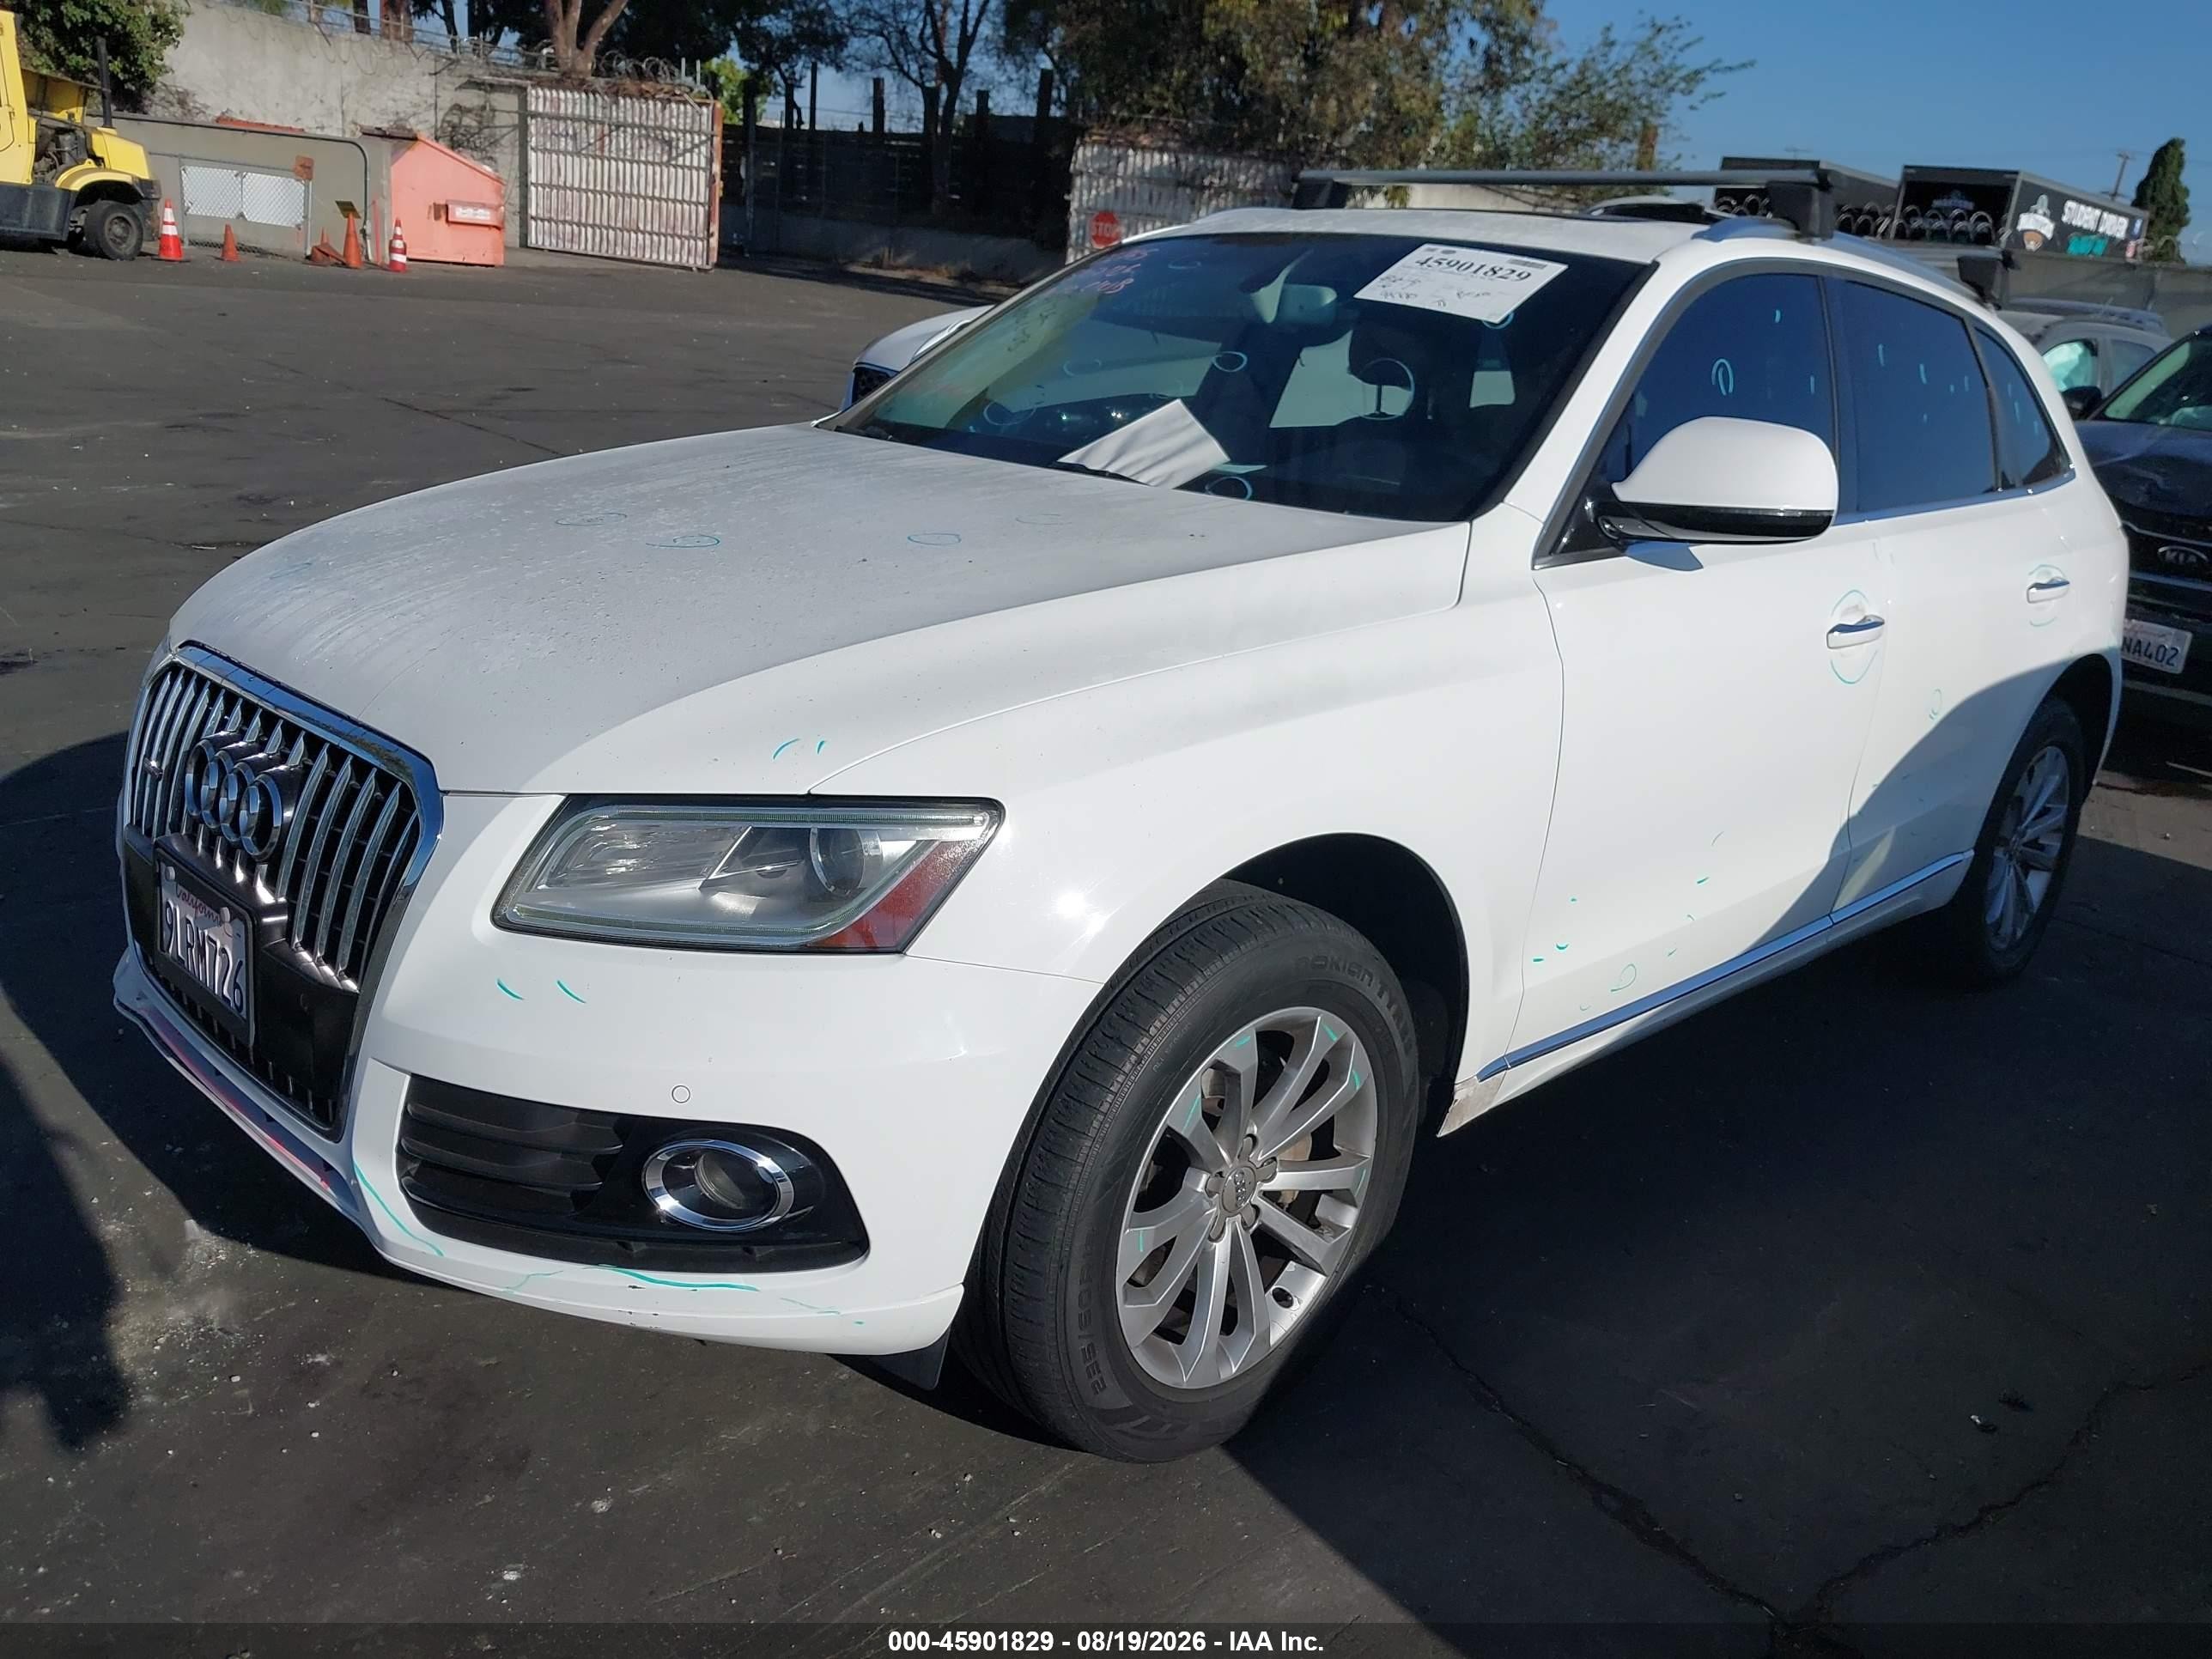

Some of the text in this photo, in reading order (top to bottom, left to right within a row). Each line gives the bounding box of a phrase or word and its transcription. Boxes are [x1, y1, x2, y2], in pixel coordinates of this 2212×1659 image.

[1091, 222, 1120, 237] STOP
[1415, 255, 1531, 283] 45901829
[2165, 550, 2198, 564] KIA
[165, 899, 244, 1014] 9LRM726
